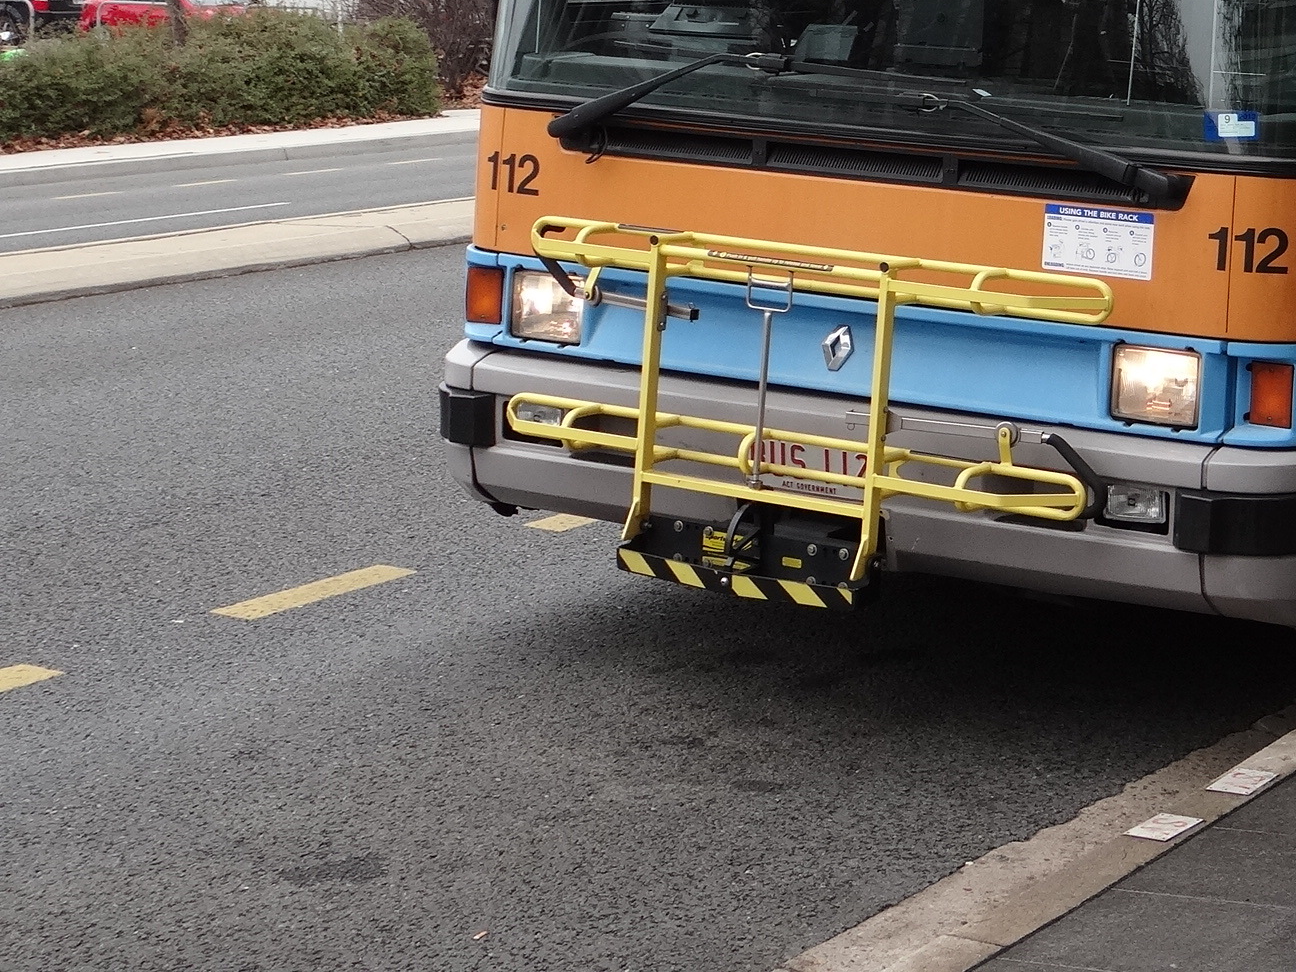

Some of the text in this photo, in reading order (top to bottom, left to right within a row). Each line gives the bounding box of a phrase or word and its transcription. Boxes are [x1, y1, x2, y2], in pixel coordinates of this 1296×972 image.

[1224, 114, 1231, 124] 9
[487, 150, 540, 197] 112
[1059, 207, 1139, 222] USING THE BIKE RACK
[1208, 227, 1289, 275] 112
[750, 440, 868, 488] BUS 112
[796, 482, 837, 495] GOVERNMENT
